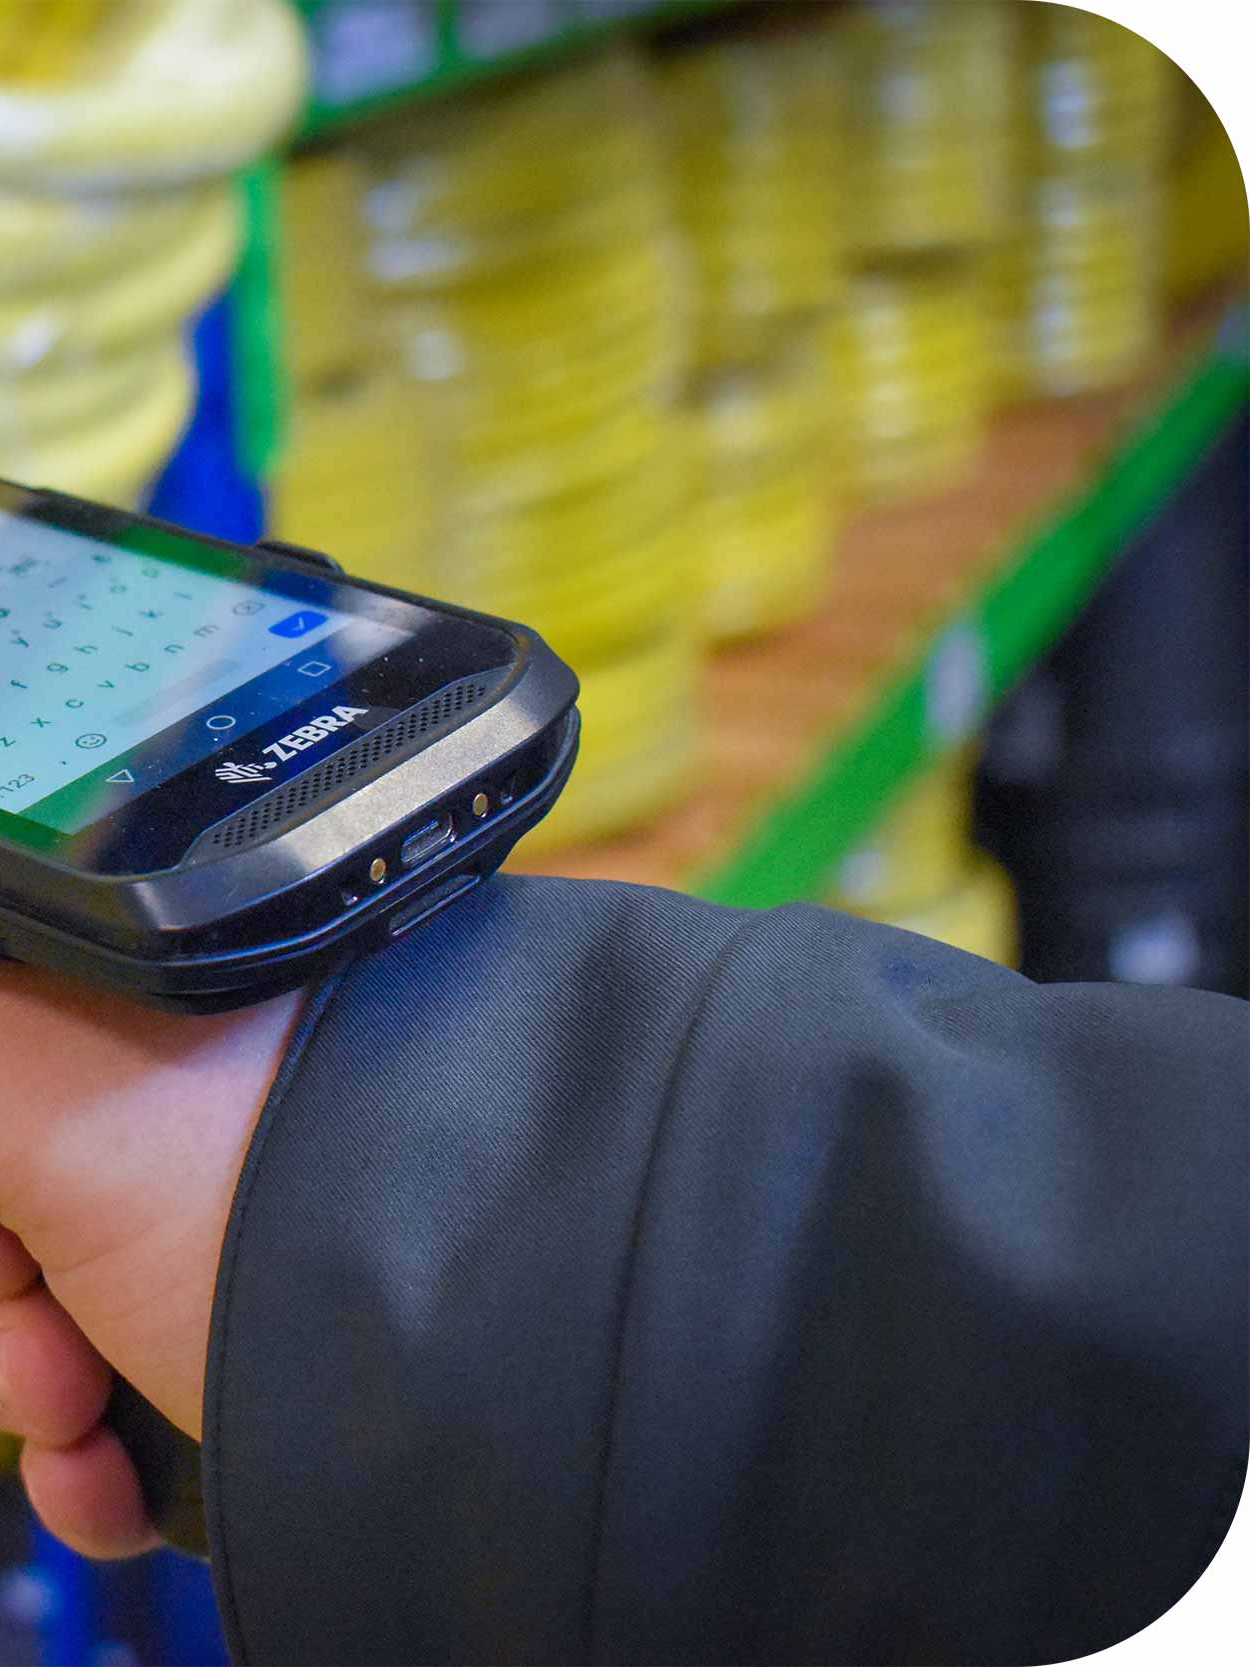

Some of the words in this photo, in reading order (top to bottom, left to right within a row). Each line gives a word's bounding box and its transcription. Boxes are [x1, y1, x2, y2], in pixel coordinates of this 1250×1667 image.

[10, 679, 28, 690] f
[46, 662, 69, 674] g
[74, 645, 98, 654] h
[30, 717, 51, 728] x
[65, 699, 84, 709] c
[97, 679, 116, 689] v
[124, 661, 150, 672] b
[163, 644, 185, 654] n
[193, 624, 221, 637] m
[262, 705, 369, 762] ZEBRA
